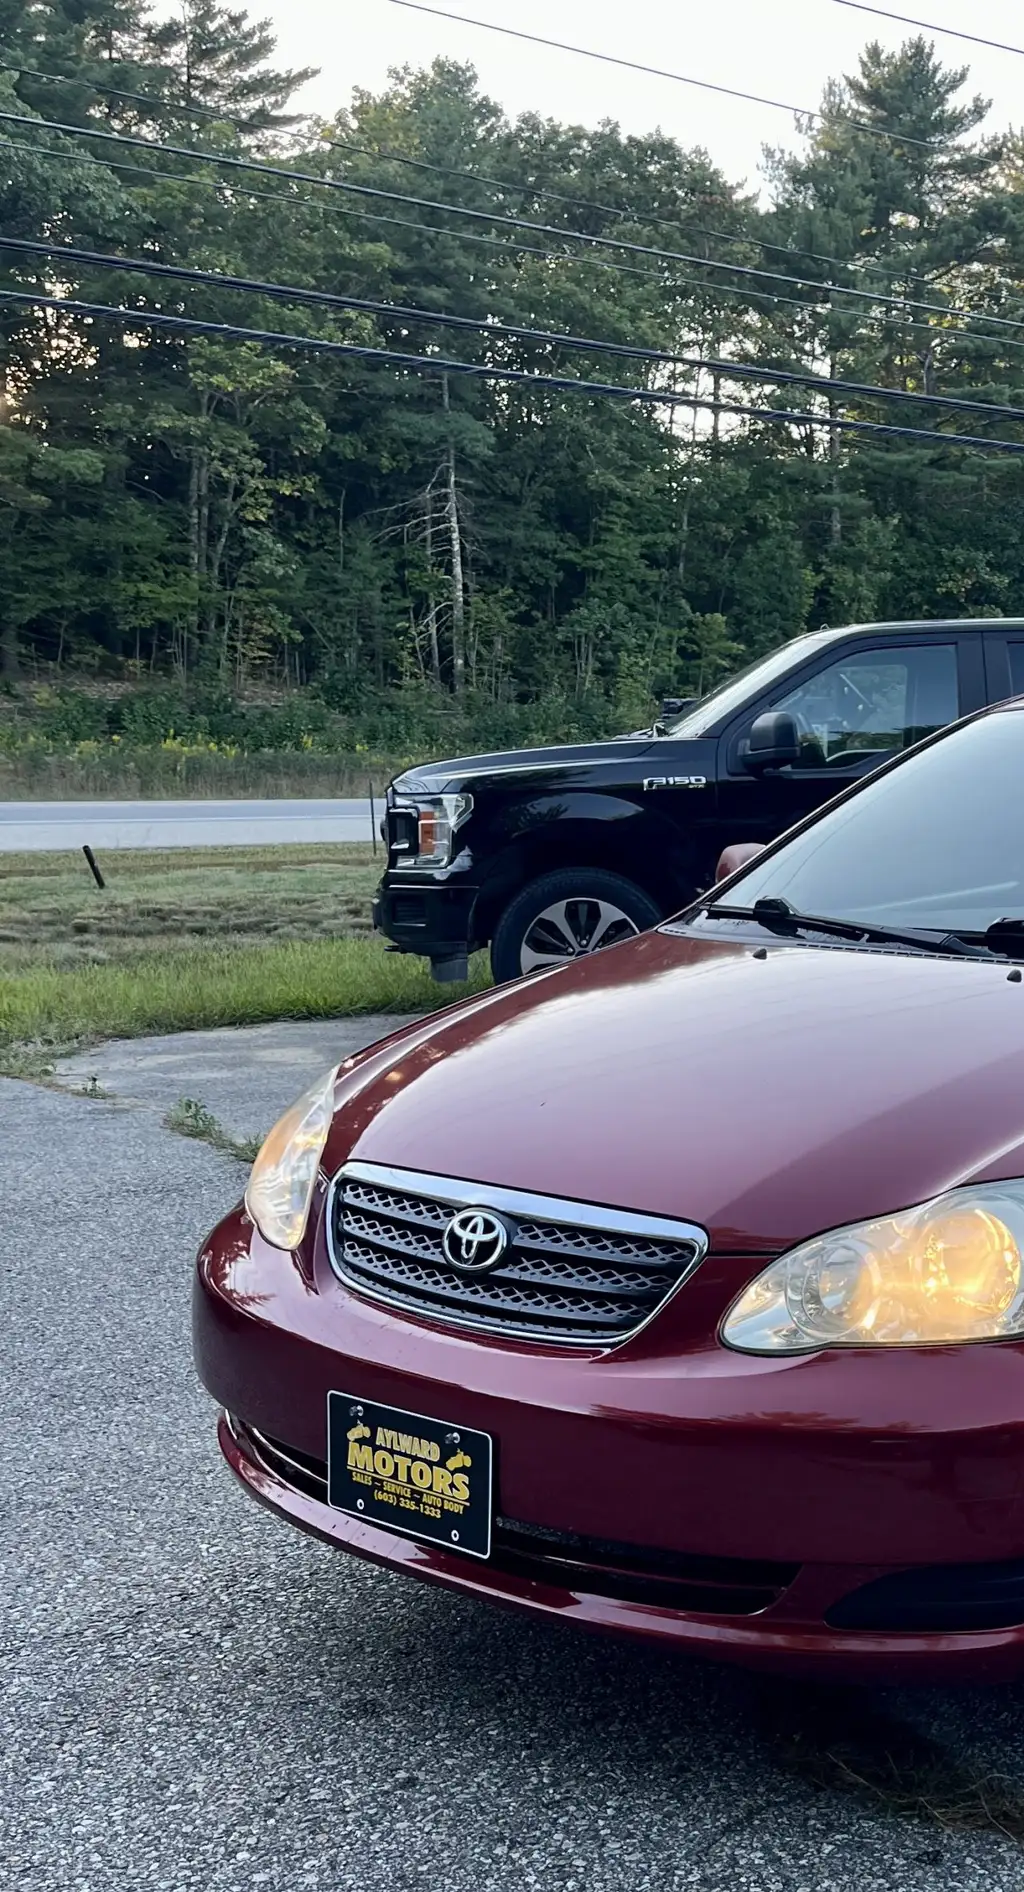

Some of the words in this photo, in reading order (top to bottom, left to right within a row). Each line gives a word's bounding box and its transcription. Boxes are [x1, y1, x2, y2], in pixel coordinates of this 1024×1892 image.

[375, 1427, 440, 1462] AYLWARD
[347, 1440, 470, 1500] MOTORS
[352, 1471, 373, 1486] SALES
[383, 1481, 411, 1498] SERVICE
[422, 1493, 442, 1507] AUTO
[444, 1501, 464, 1515] BODY
[374, 1490, 397, 1506] (603)
[399, 1499, 441, 1518] 335-1333
